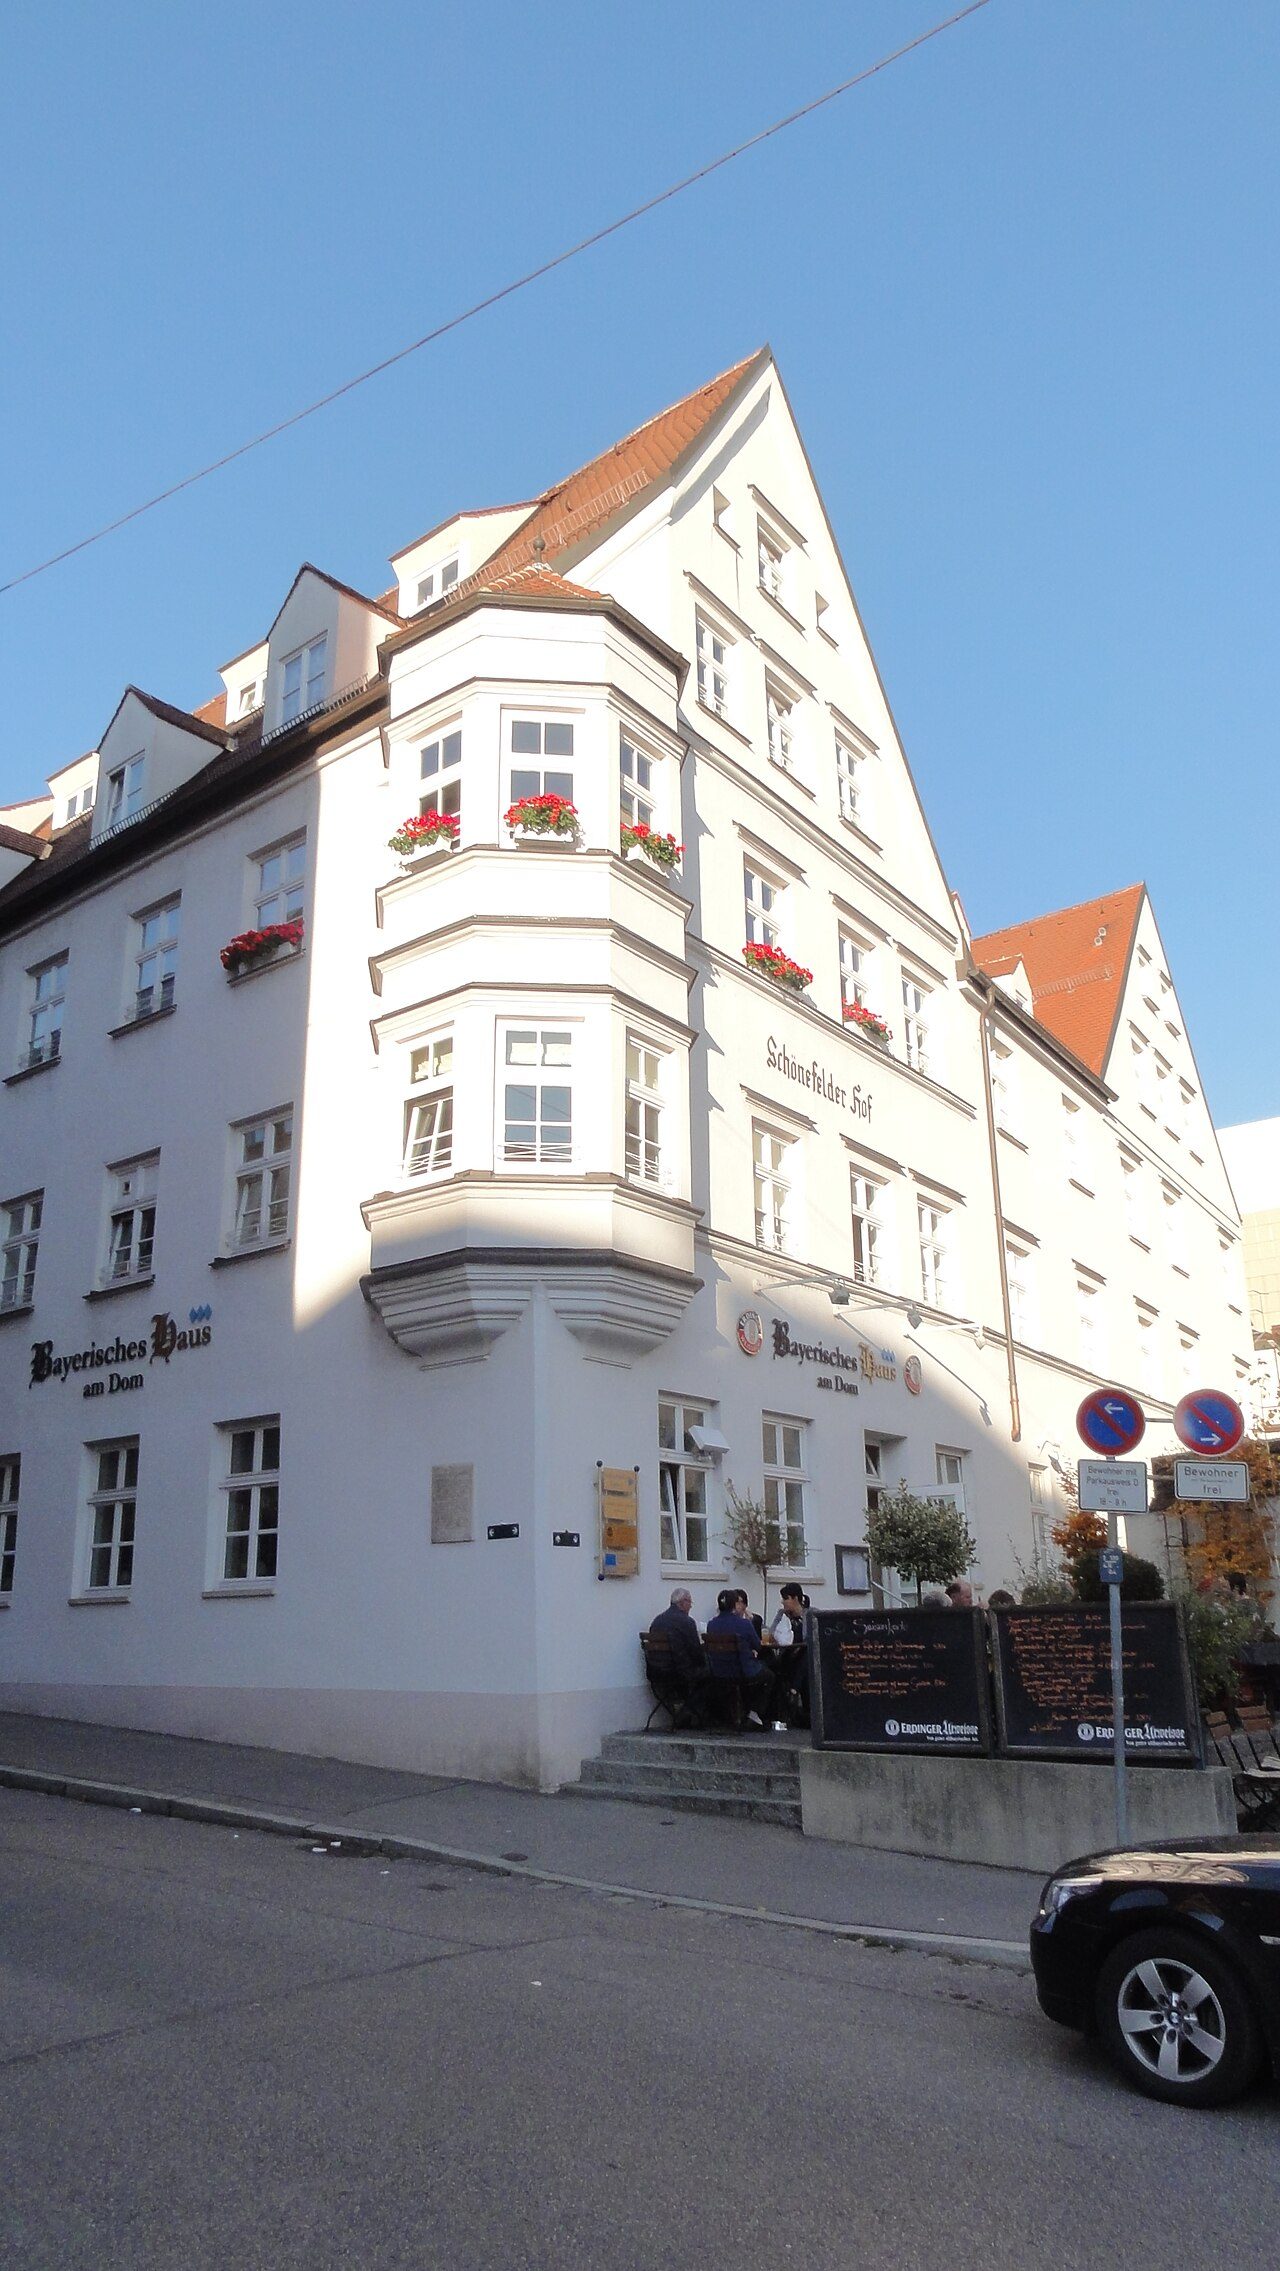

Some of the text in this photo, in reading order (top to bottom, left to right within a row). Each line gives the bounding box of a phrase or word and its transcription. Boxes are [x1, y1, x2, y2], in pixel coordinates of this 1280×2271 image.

[766, 1035, 873, 1124] Schönefelder Hof
[29, 1311, 212, 1389] Bayerisches Haus
[772, 1318, 897, 1384] Bayerisches Haus
[83, 1372, 144, 1398] am Dom
[817, 1375, 859, 1395] am Dom
[1184, 1466, 1239, 1478] Bewohner
[1203, 1485, 1222, 1494] frei
[901, 1722, 942, 1735] ERDINGER
[1095, 1726, 1144, 1739] ERDGER
